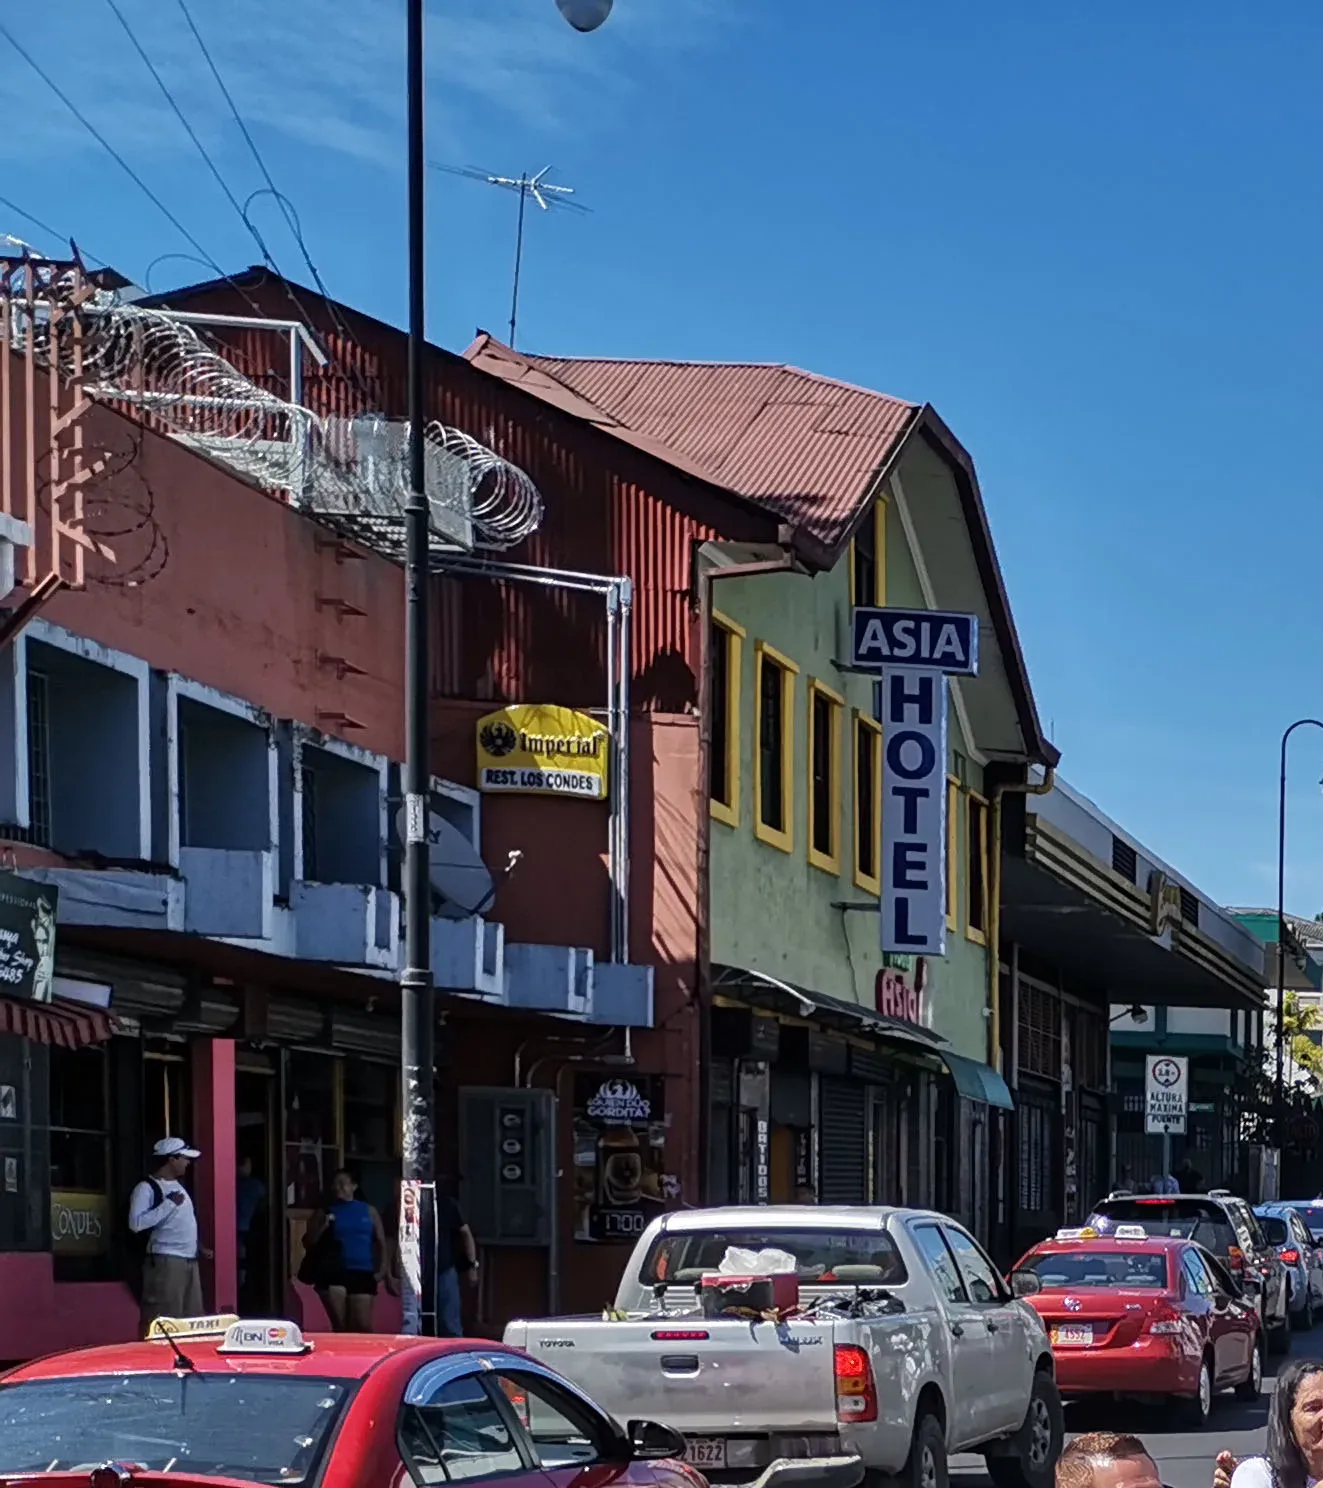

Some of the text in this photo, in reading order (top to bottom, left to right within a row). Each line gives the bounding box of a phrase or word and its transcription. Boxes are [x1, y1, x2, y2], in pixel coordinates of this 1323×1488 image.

[858, 619, 965, 661] ASIA
[519, 728, 599, 759] Imperial
[485, 769, 593, 790] REST. LOS CONDES
[886, 675, 937, 947] HOTEL
[1150, 1092, 1183, 1103] ALTURA
[188, 1319, 220, 1331] TAXI
[244, 1332, 263, 1341] BN
[539, 1338, 575, 1348] TOYOTA
